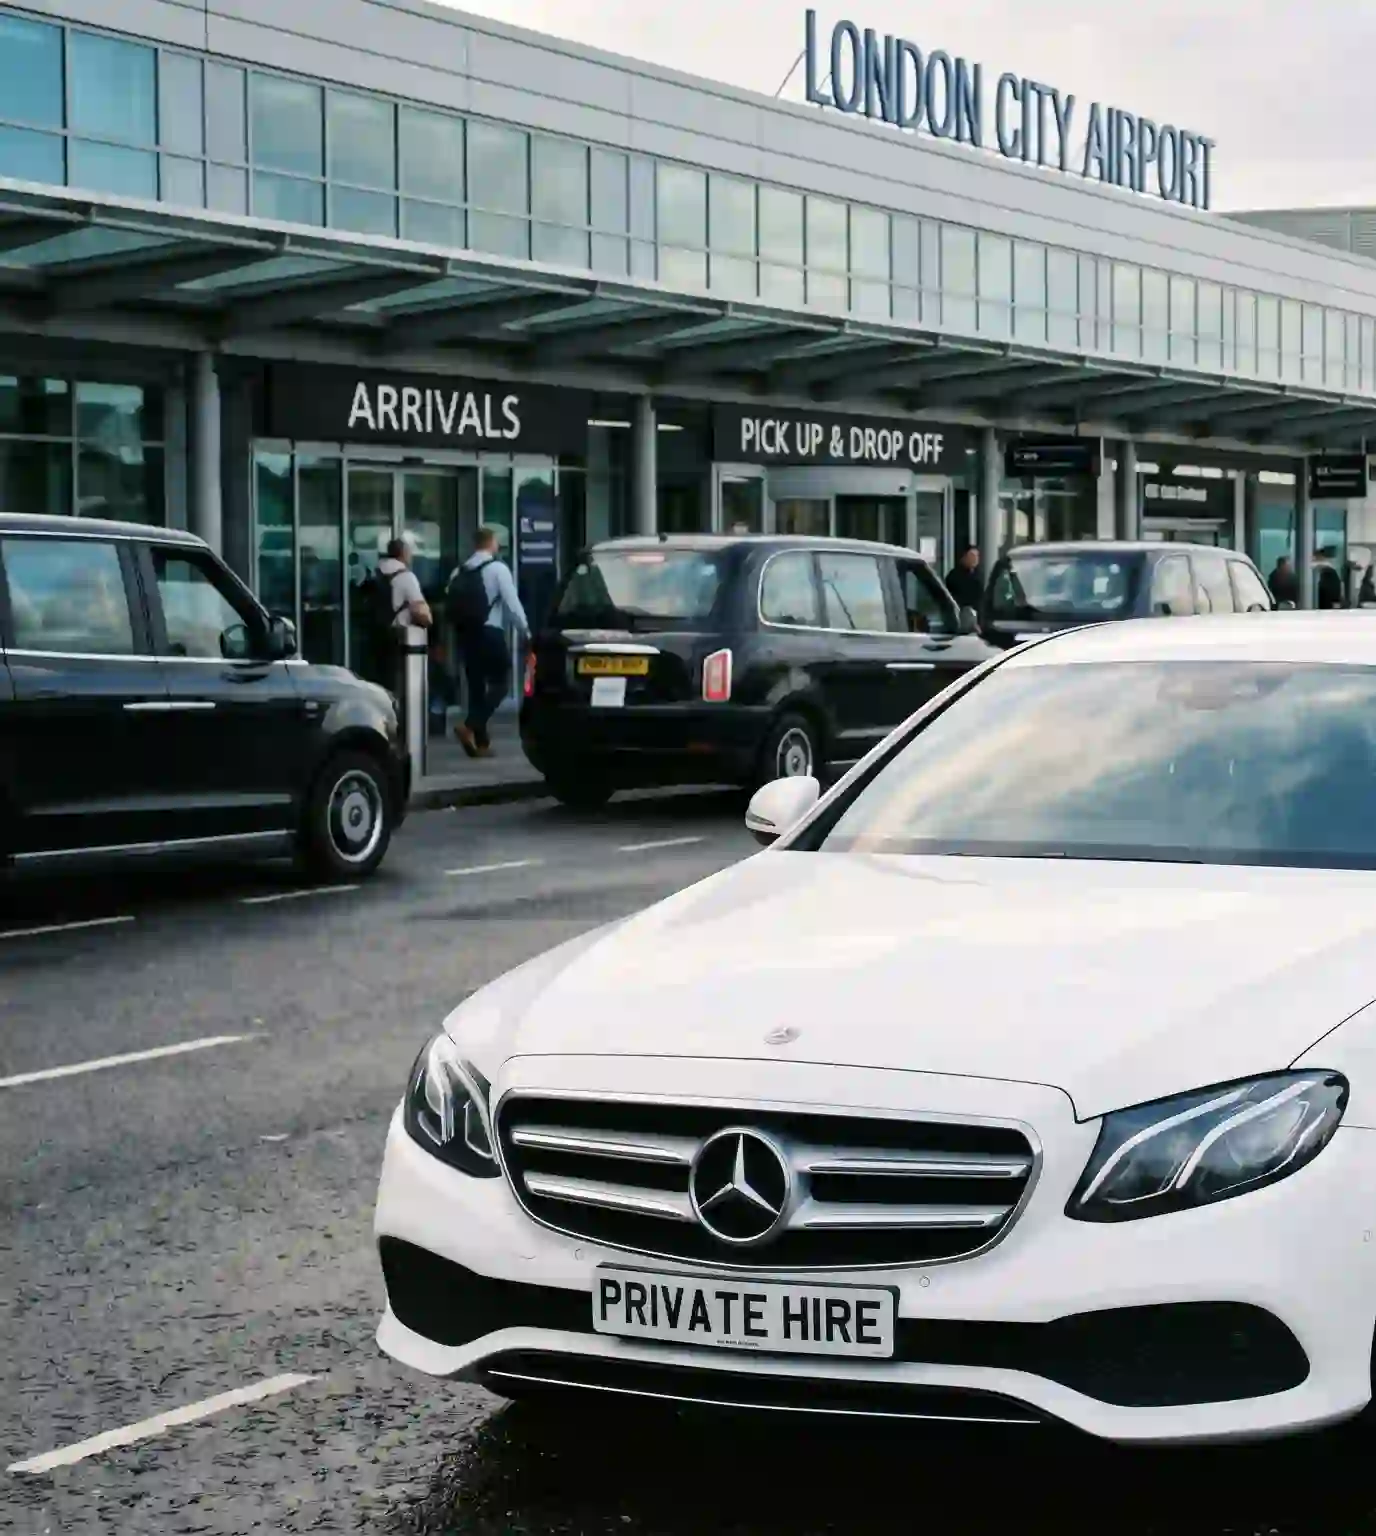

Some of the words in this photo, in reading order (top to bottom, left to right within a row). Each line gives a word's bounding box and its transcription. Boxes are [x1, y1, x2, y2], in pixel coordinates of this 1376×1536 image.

[806, 9, 982, 147] LONDON
[996, 72, 1075, 171] CITY
[1083, 102, 1216, 210] AIRPORT
[348, 382, 521, 439] ARRIVALS
[741, 417, 790, 454] PICK
[796, 422, 823, 456] UP
[830, 425, 844, 458] &
[850, 426, 903, 461] DROP
[909, 432, 944, 464] OFF
[600, 1278, 768, 1337] PRIVATE
[782, 1295, 882, 1345] HIRE
